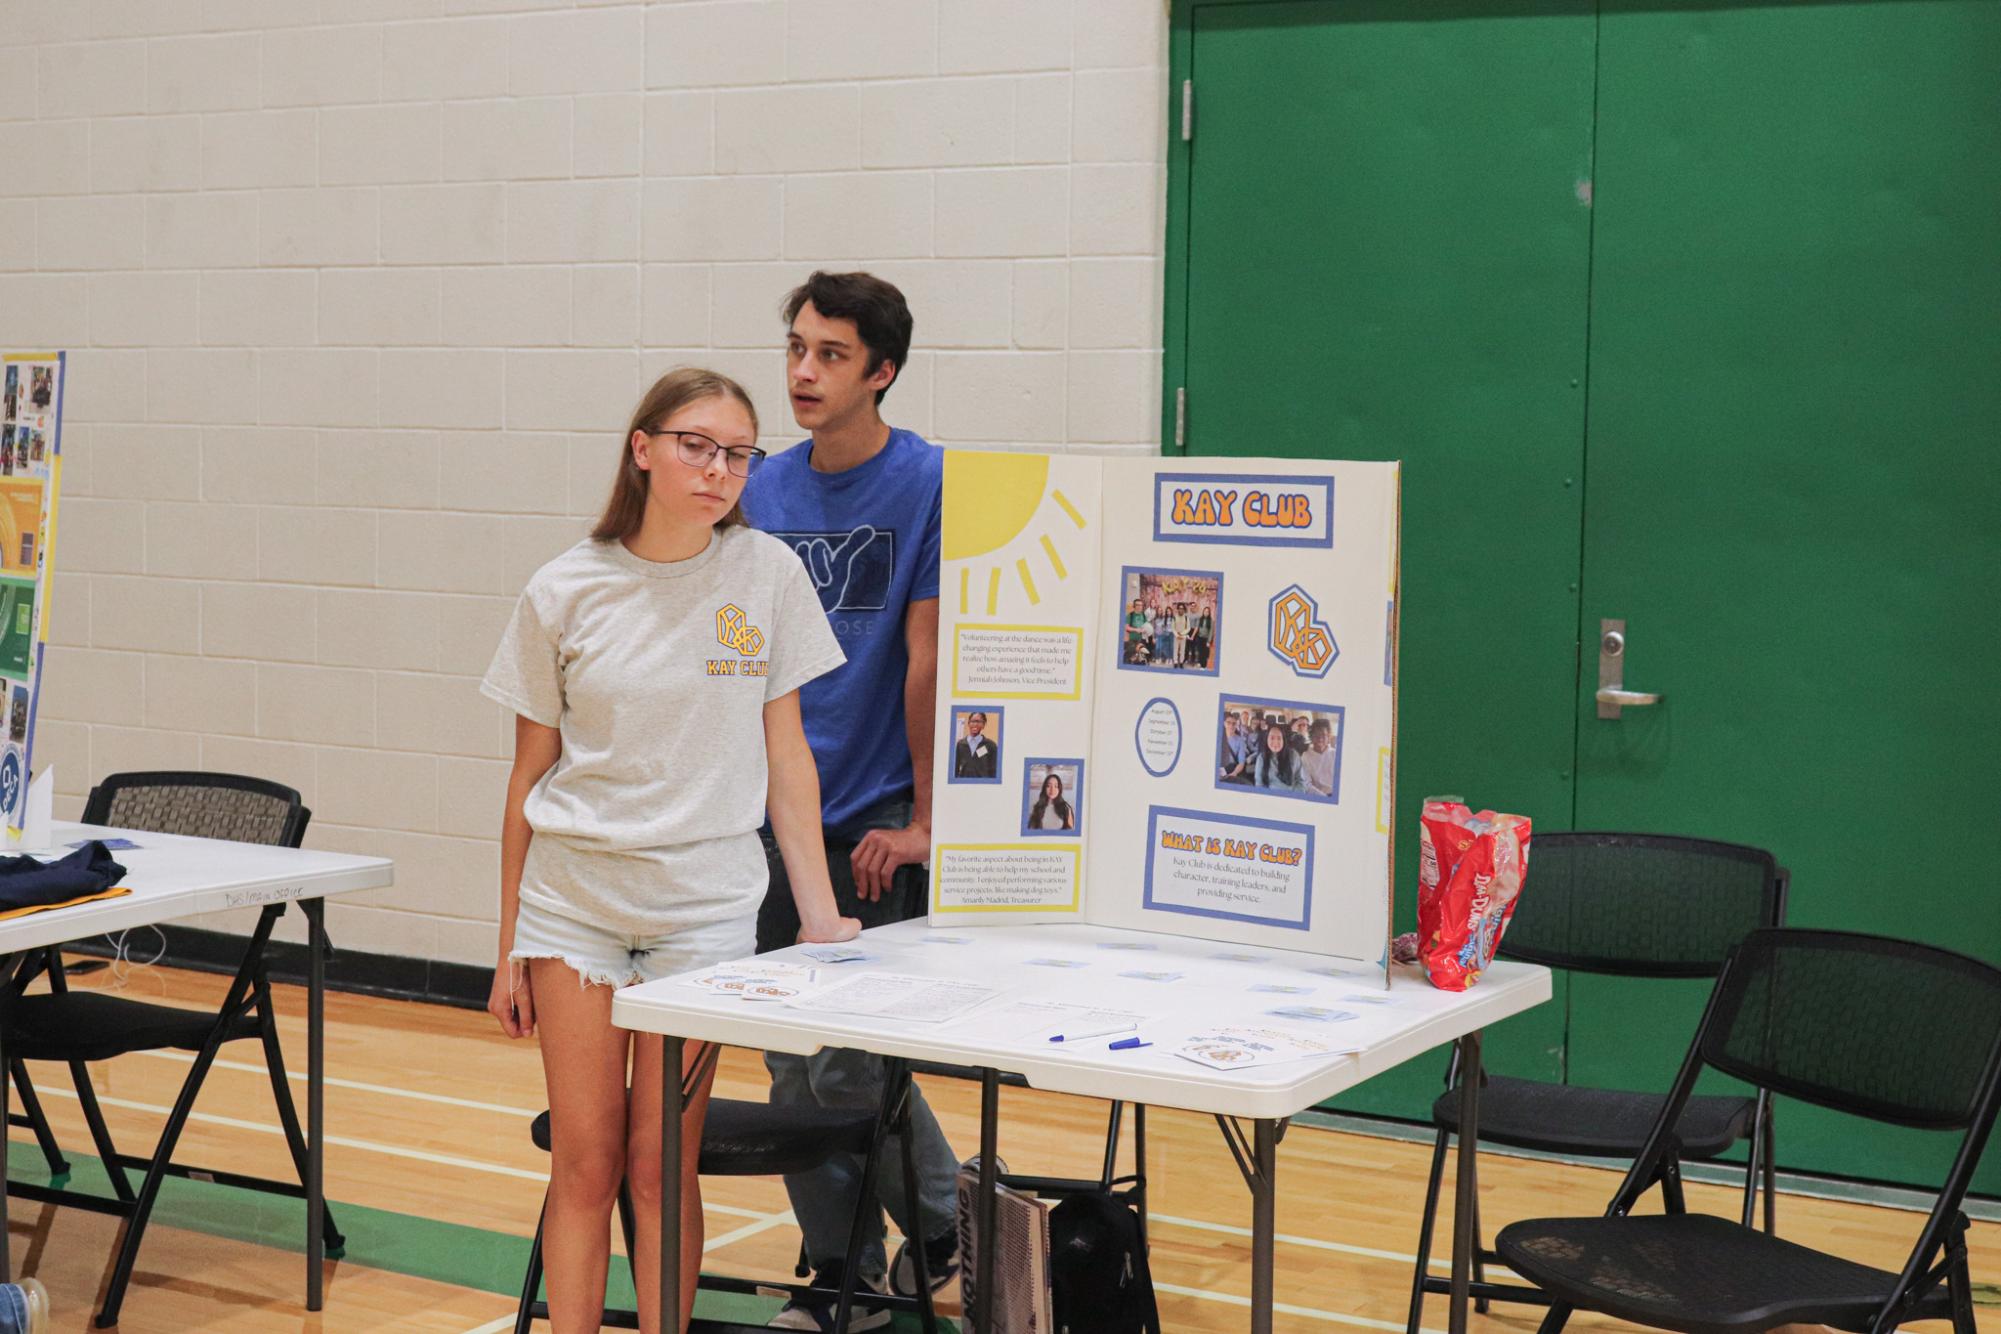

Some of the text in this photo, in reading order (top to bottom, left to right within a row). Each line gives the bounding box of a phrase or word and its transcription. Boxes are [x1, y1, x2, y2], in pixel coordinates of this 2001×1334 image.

[1171, 488, 1312, 529] KAY CLUB
[1012, 634, 1022, 643] the
[1023, 635, 1041, 644] dance
[962, 644, 992, 654] changing
[992, 646, 1026, 655] experience
[1027, 646, 1040, 654] that
[1040, 646, 1059, 654] made
[998, 656, 1024, 664] amazing
[1054, 656, 1069, 666] help
[706, 660, 736, 676] KAY
[976, 664, 997, 673] others
[997, 665, 1013, 673] have
[1019, 665, 1036, 675] good
[1022, 676, 1034, 684] Vice
[1036, 676, 1066, 685] President
[1162, 830, 1303, 867] WHAT IS KAY CLUB?
[982, 856, 1004, 864] aspect
[1024, 856, 1043, 864] being
[963, 866, 982, 874] being
[1004, 866, 1018, 875] help
[1030, 866, 1051, 874] school
[1052, 866, 1066, 874] and
[1173, 856, 1187, 867] Kay
[1188, 858, 1206, 869] Club
[1213, 862, 1250, 876] dedicated
[1251, 867, 1260, 876] to
[1260, 868, 1290, 882] building
[1006, 876, 1043, 885] performing
[1173, 870, 1210, 882] character,
[1212, 876, 1241, 888] training
[1271, 884, 1287, 894] and
[994, 886, 1006, 894] like
[1006, 886, 1032, 895] making
[1031, 886, 1044, 895] dog
[1196, 888, 1232, 901] providing
[1010, 896, 1042, 904] Treasurer
[959, 1189, 976, 1328] NOTHING
